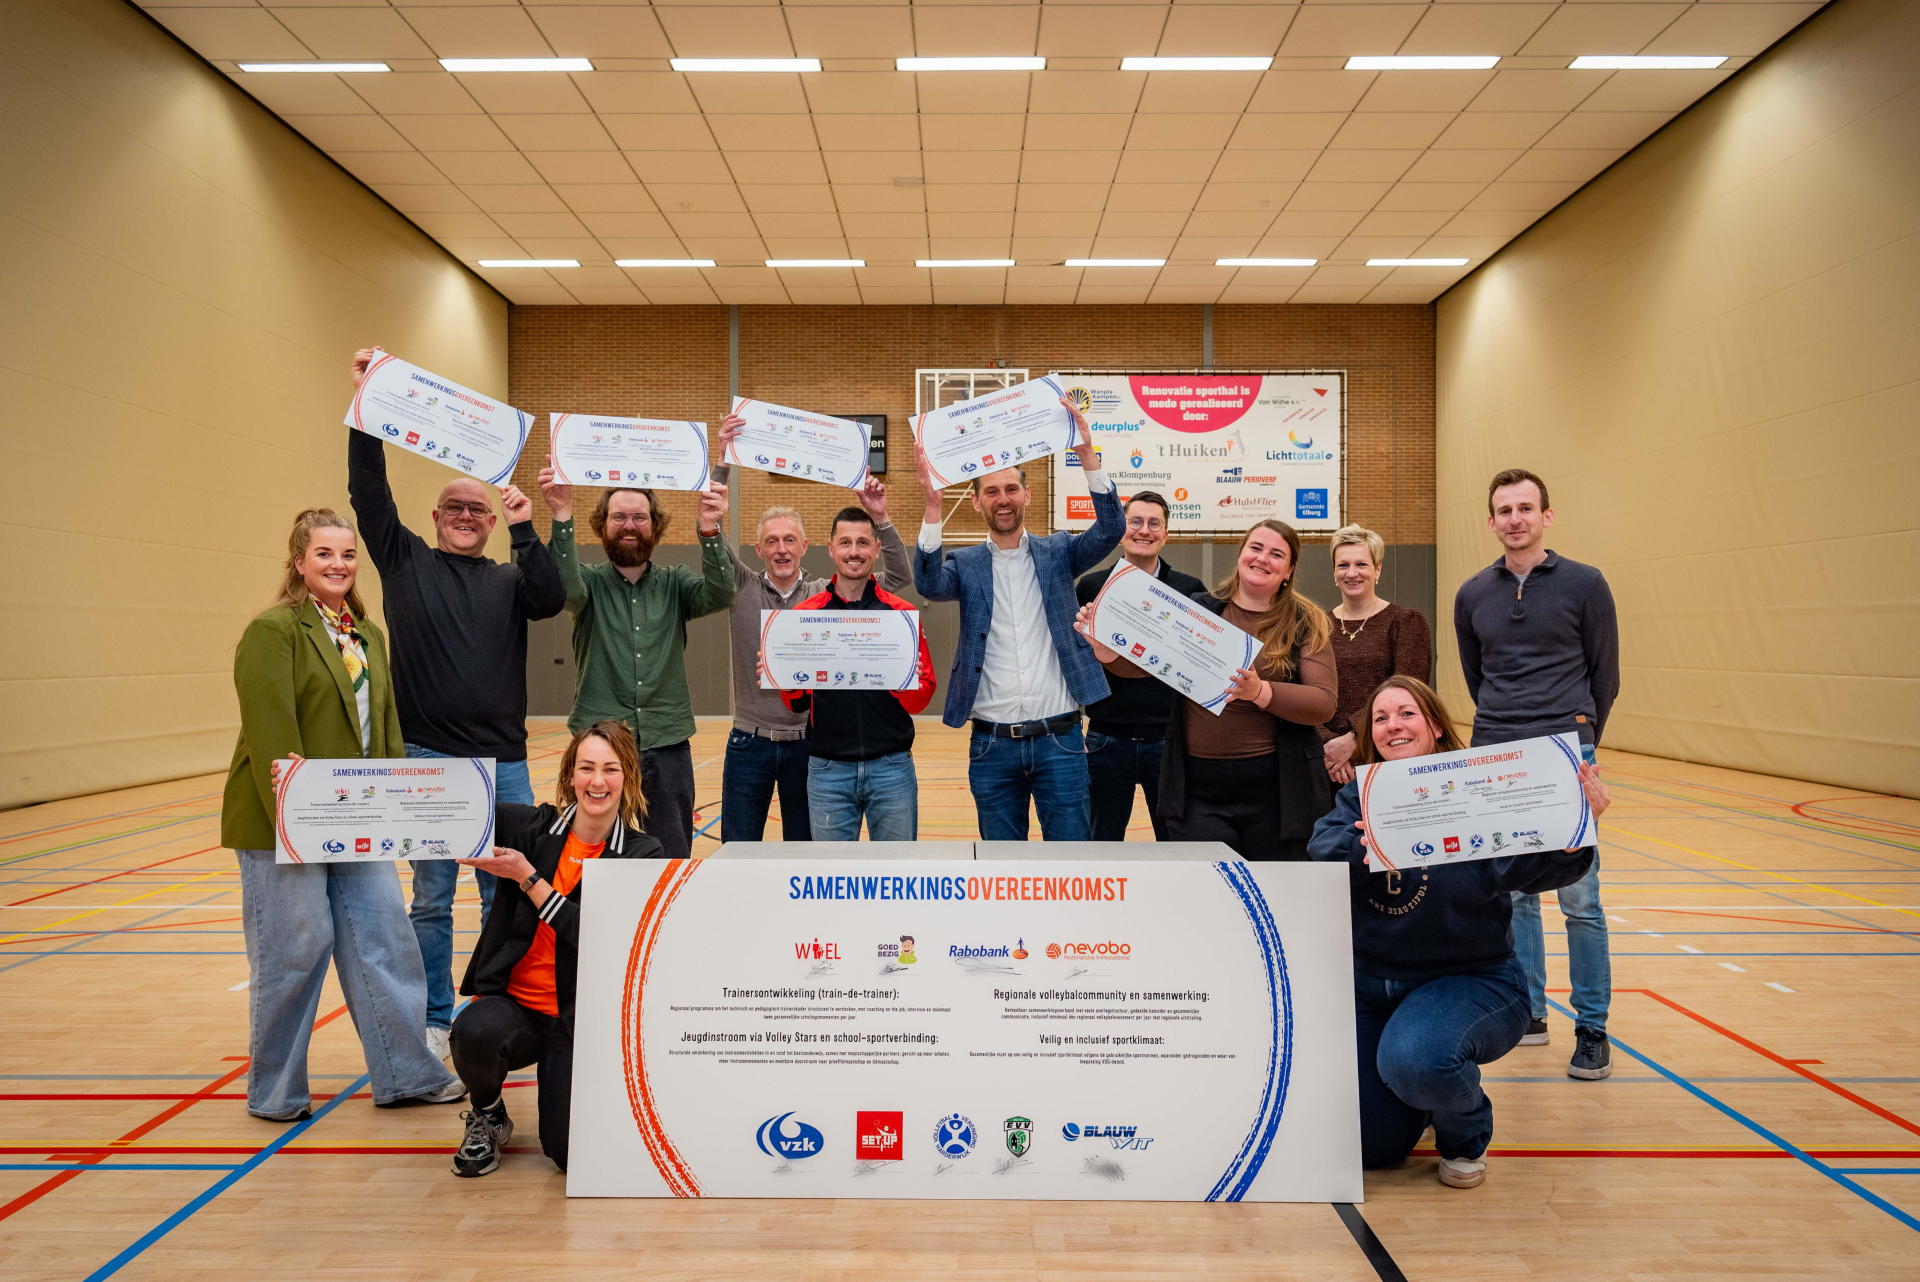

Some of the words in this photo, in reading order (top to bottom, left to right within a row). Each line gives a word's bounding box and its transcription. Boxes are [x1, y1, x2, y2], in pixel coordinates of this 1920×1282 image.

[411, 373, 495, 413] SAMENWERKINGSOVEREENKOMST
[1142, 386, 1193, 396] Renovatie
[1195, 386, 1238, 398] sporthal
[1241, 386, 1250, 396] is
[948, 390, 1026, 418] SAMENWERKINGSOVEREENKOMST
[1149, 398, 1177, 408] mede
[1180, 398, 1243, 411] gerealiseerd
[1183, 411, 1209, 421] door:
[1091, 422, 1139, 433] deurplus
[1169, 444, 1227, 457] Huiken
[1266, 450, 1324, 460] Lichttotaal
[1119, 471, 1171, 480] Klompenburg
[1234, 498, 1277, 506] HulstFlier
[1148, 585, 1225, 634] SAMENWERKINGSOVEREENKOMST
[1408, 750, 1523, 775] SAMENWERKINGSOVEREENKOMST
[332, 768, 445, 776] SAMENWERKINGSOVEREENKOMST
[789, 875, 1128, 901] SAMENWERKINGSOVEREENKOMST
[1387, 885, 1428, 915] BEAUTIFUL
[949, 945, 1009, 958] Rabobank
[1064, 940, 1131, 955] nevobo
[723, 988, 815, 1000] Trainersontwikkeling
[819, 988, 900, 1000] (train-de-trainer):
[994, 989, 1036, 1001] Regionale
[1040, 989, 1126, 1002] volleybalcommunity
[1144, 990, 1210, 1002] samenwerking:
[681, 1032, 746, 1044] Jeugdinstroom
[750, 1032, 762, 1042] via
[766, 1032, 791, 1044] Volley
[795, 1032, 816, 1042] Stars
[834, 1032, 939, 1044] school-sportverbinding:
[1040, 1035, 1061, 1045] Veilig
[1076, 1035, 1109, 1044] inclusief
[1113, 1035, 1165, 1046] sportklimaat:
[933, 1115, 952, 1143] VOLLEYBAL
[961, 1115, 978, 1149] VERENIGING
[1084, 1126, 1137, 1138] BLAUW
[780, 1139, 815, 1152] vzk
[1109, 1137, 1154, 1150] WIT
[935, 1144, 971, 1160] HARDERWIJK
